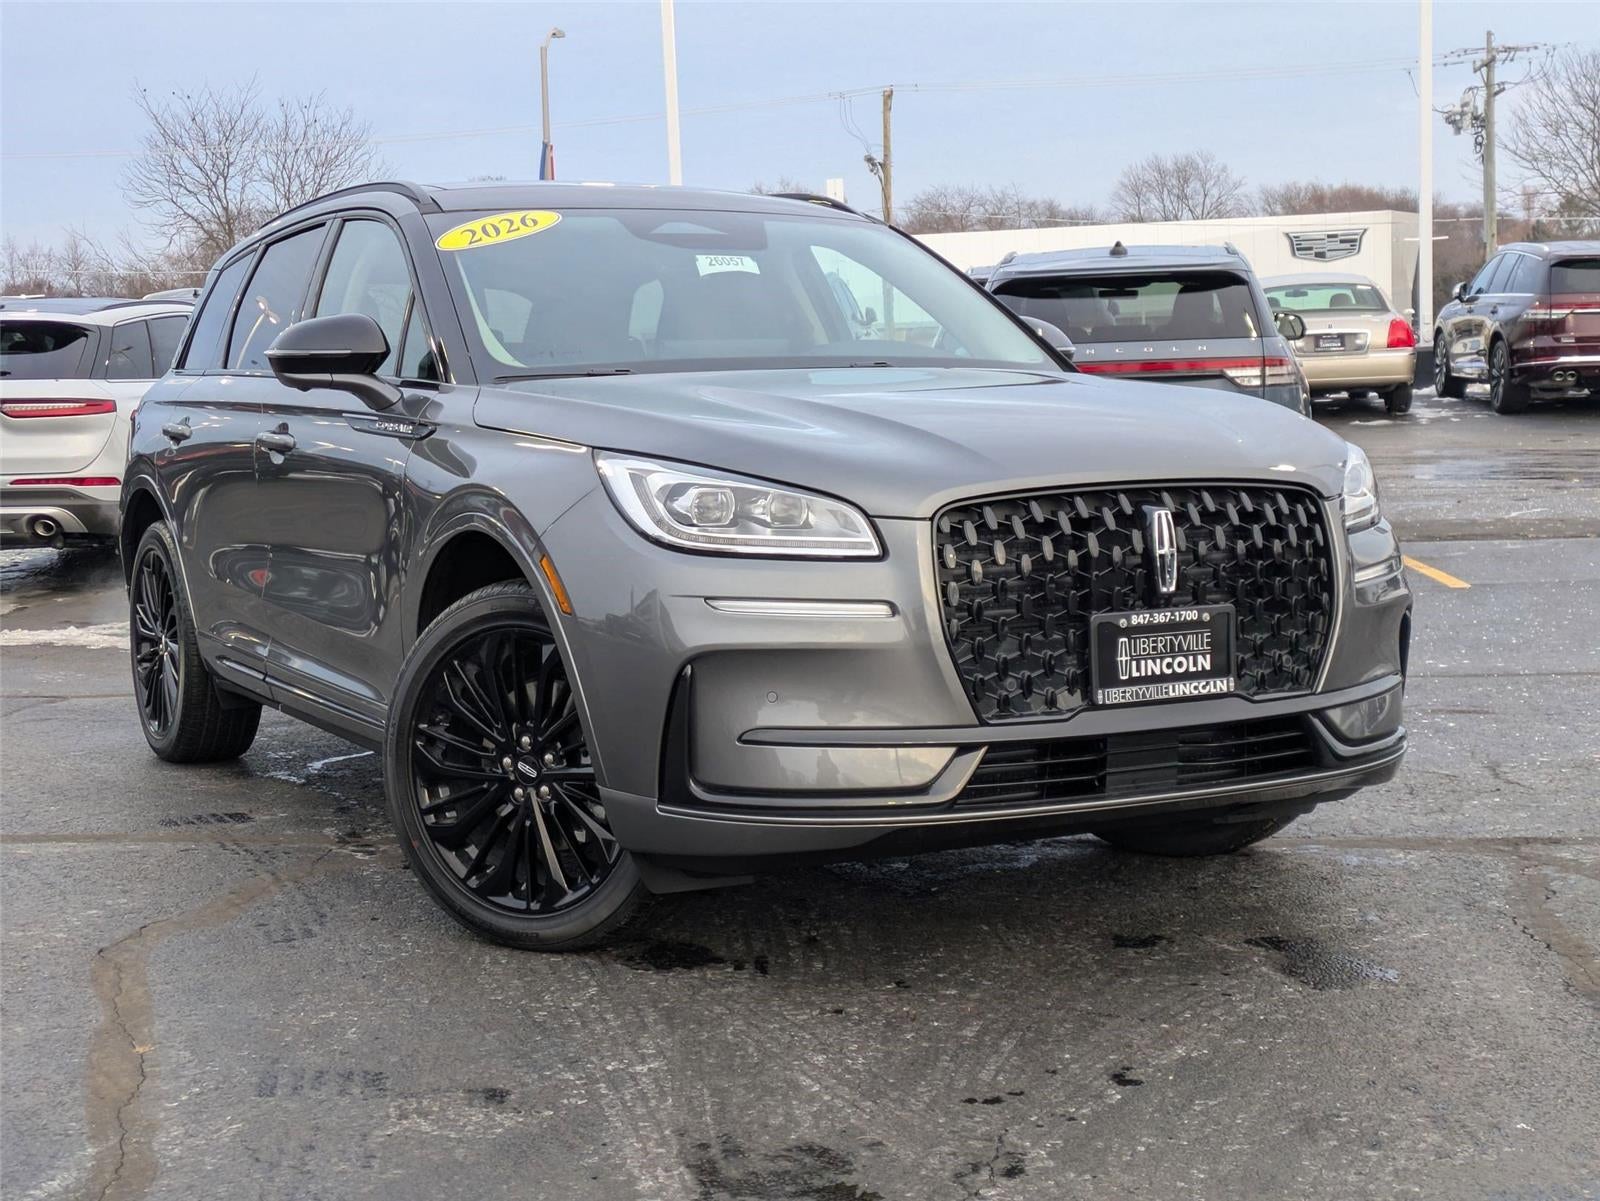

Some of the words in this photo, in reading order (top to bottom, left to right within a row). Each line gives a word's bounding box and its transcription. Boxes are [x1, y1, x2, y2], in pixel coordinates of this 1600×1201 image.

[460, 213, 539, 245] 2026
[705, 256, 745, 267] 26057
[1085, 344, 1207, 355] NCOLN
[1131, 610, 1198, 625] 847-367-1700
[1131, 633, 1211, 655] LIBERTYVILLE
[1131, 654, 1212, 677] LINCOLN
